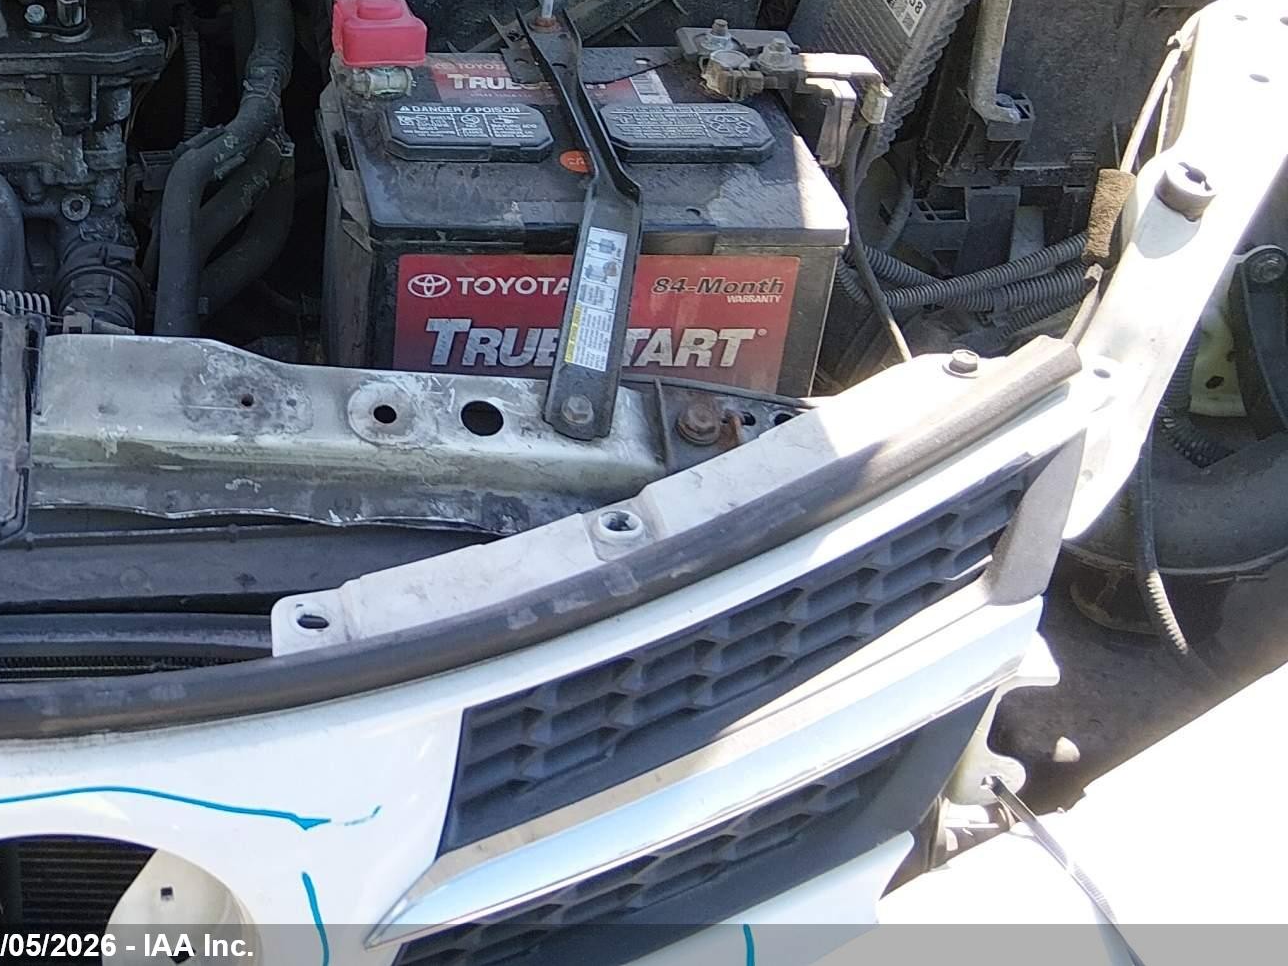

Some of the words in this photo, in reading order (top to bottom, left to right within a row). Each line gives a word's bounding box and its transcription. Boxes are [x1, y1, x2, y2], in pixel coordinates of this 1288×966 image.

[456, 276, 570, 296] TOYOTA
[651, 276, 785, 295] 84-Month
[726, 294, 783, 304] WARRANTY
